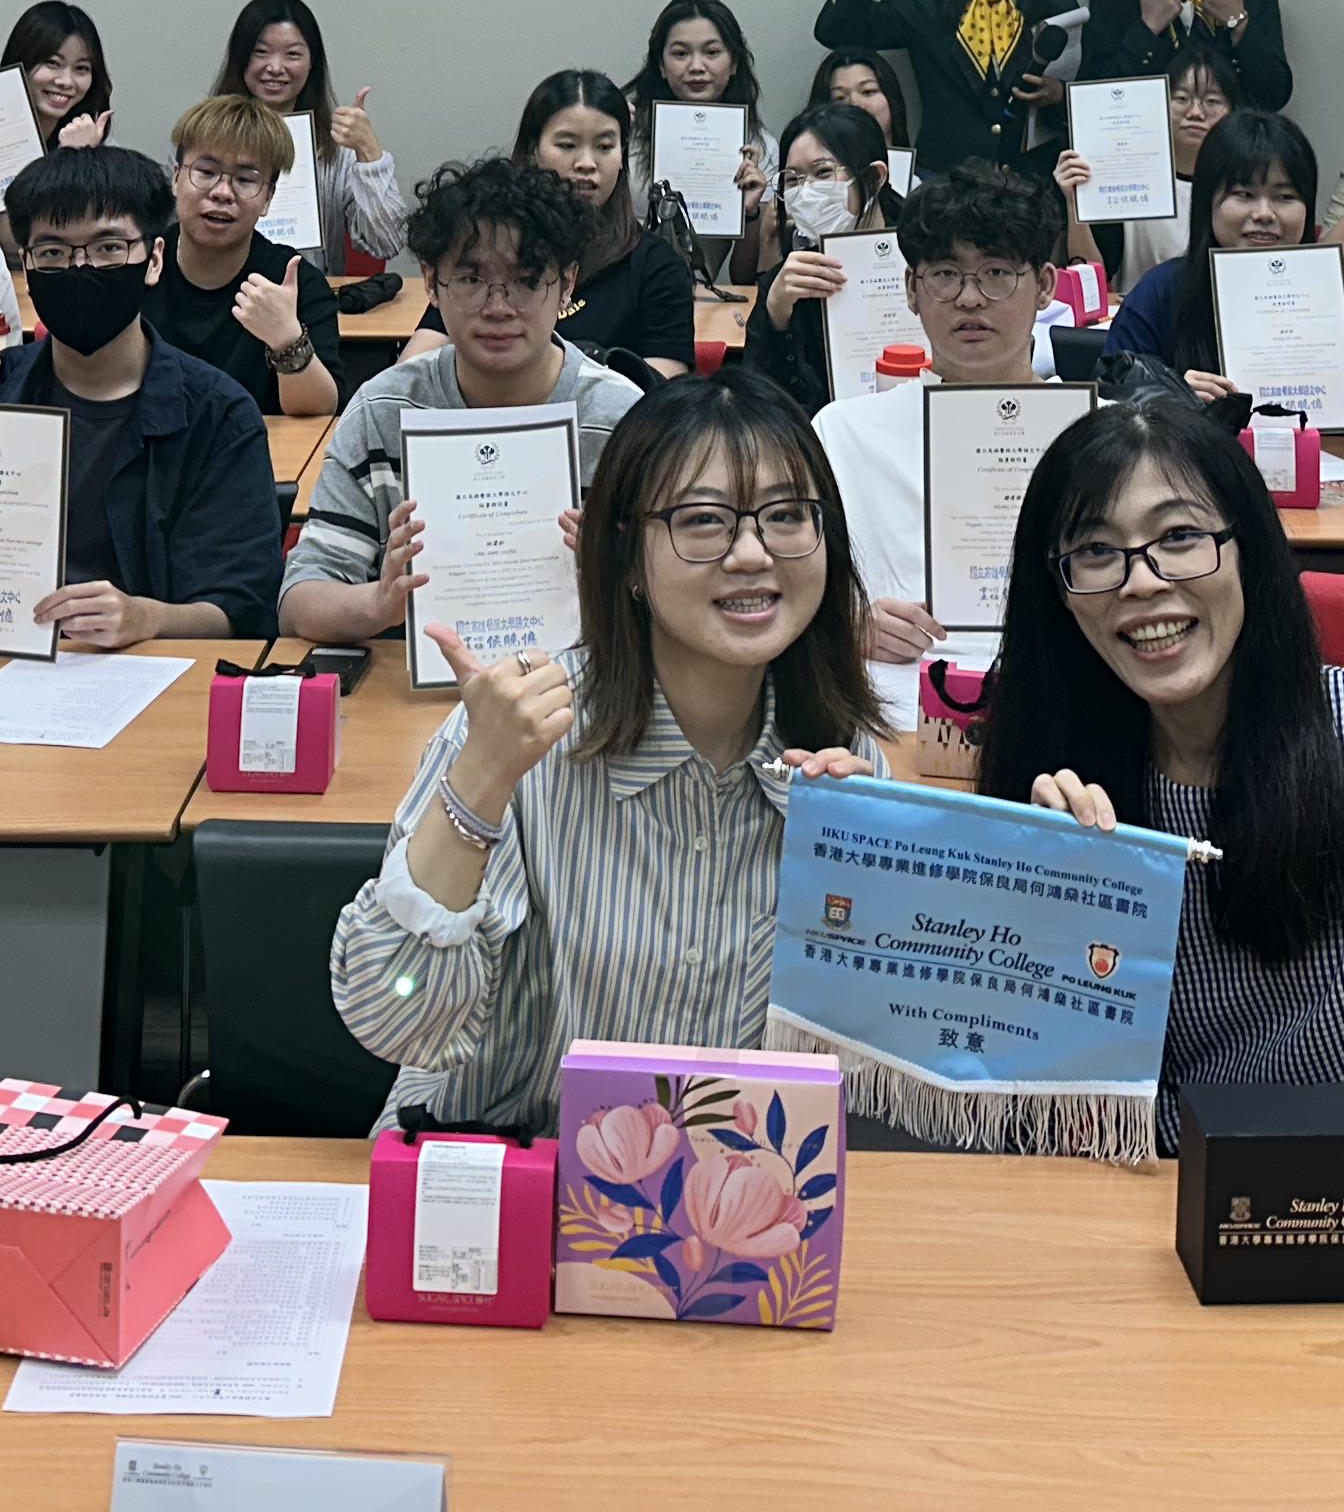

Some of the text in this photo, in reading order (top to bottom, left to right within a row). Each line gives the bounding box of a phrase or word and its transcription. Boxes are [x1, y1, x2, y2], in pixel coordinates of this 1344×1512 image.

[822, 826, 1143, 897] HKU SPACE Po Leung Kuk Stanley Ho Community College
[912, 912, 1022, 946] Stanley Ho
[874, 932, 1055, 980] Community College
[1061, 974, 1137, 1001] PO LEUNG KUK
[889, 1002, 1040, 1041] With Compliments
[938, 1028, 985, 1054] 致意
[1289, 1197, 1339, 1215] Stanley
[1265, 1215, 1339, 1232] Community
